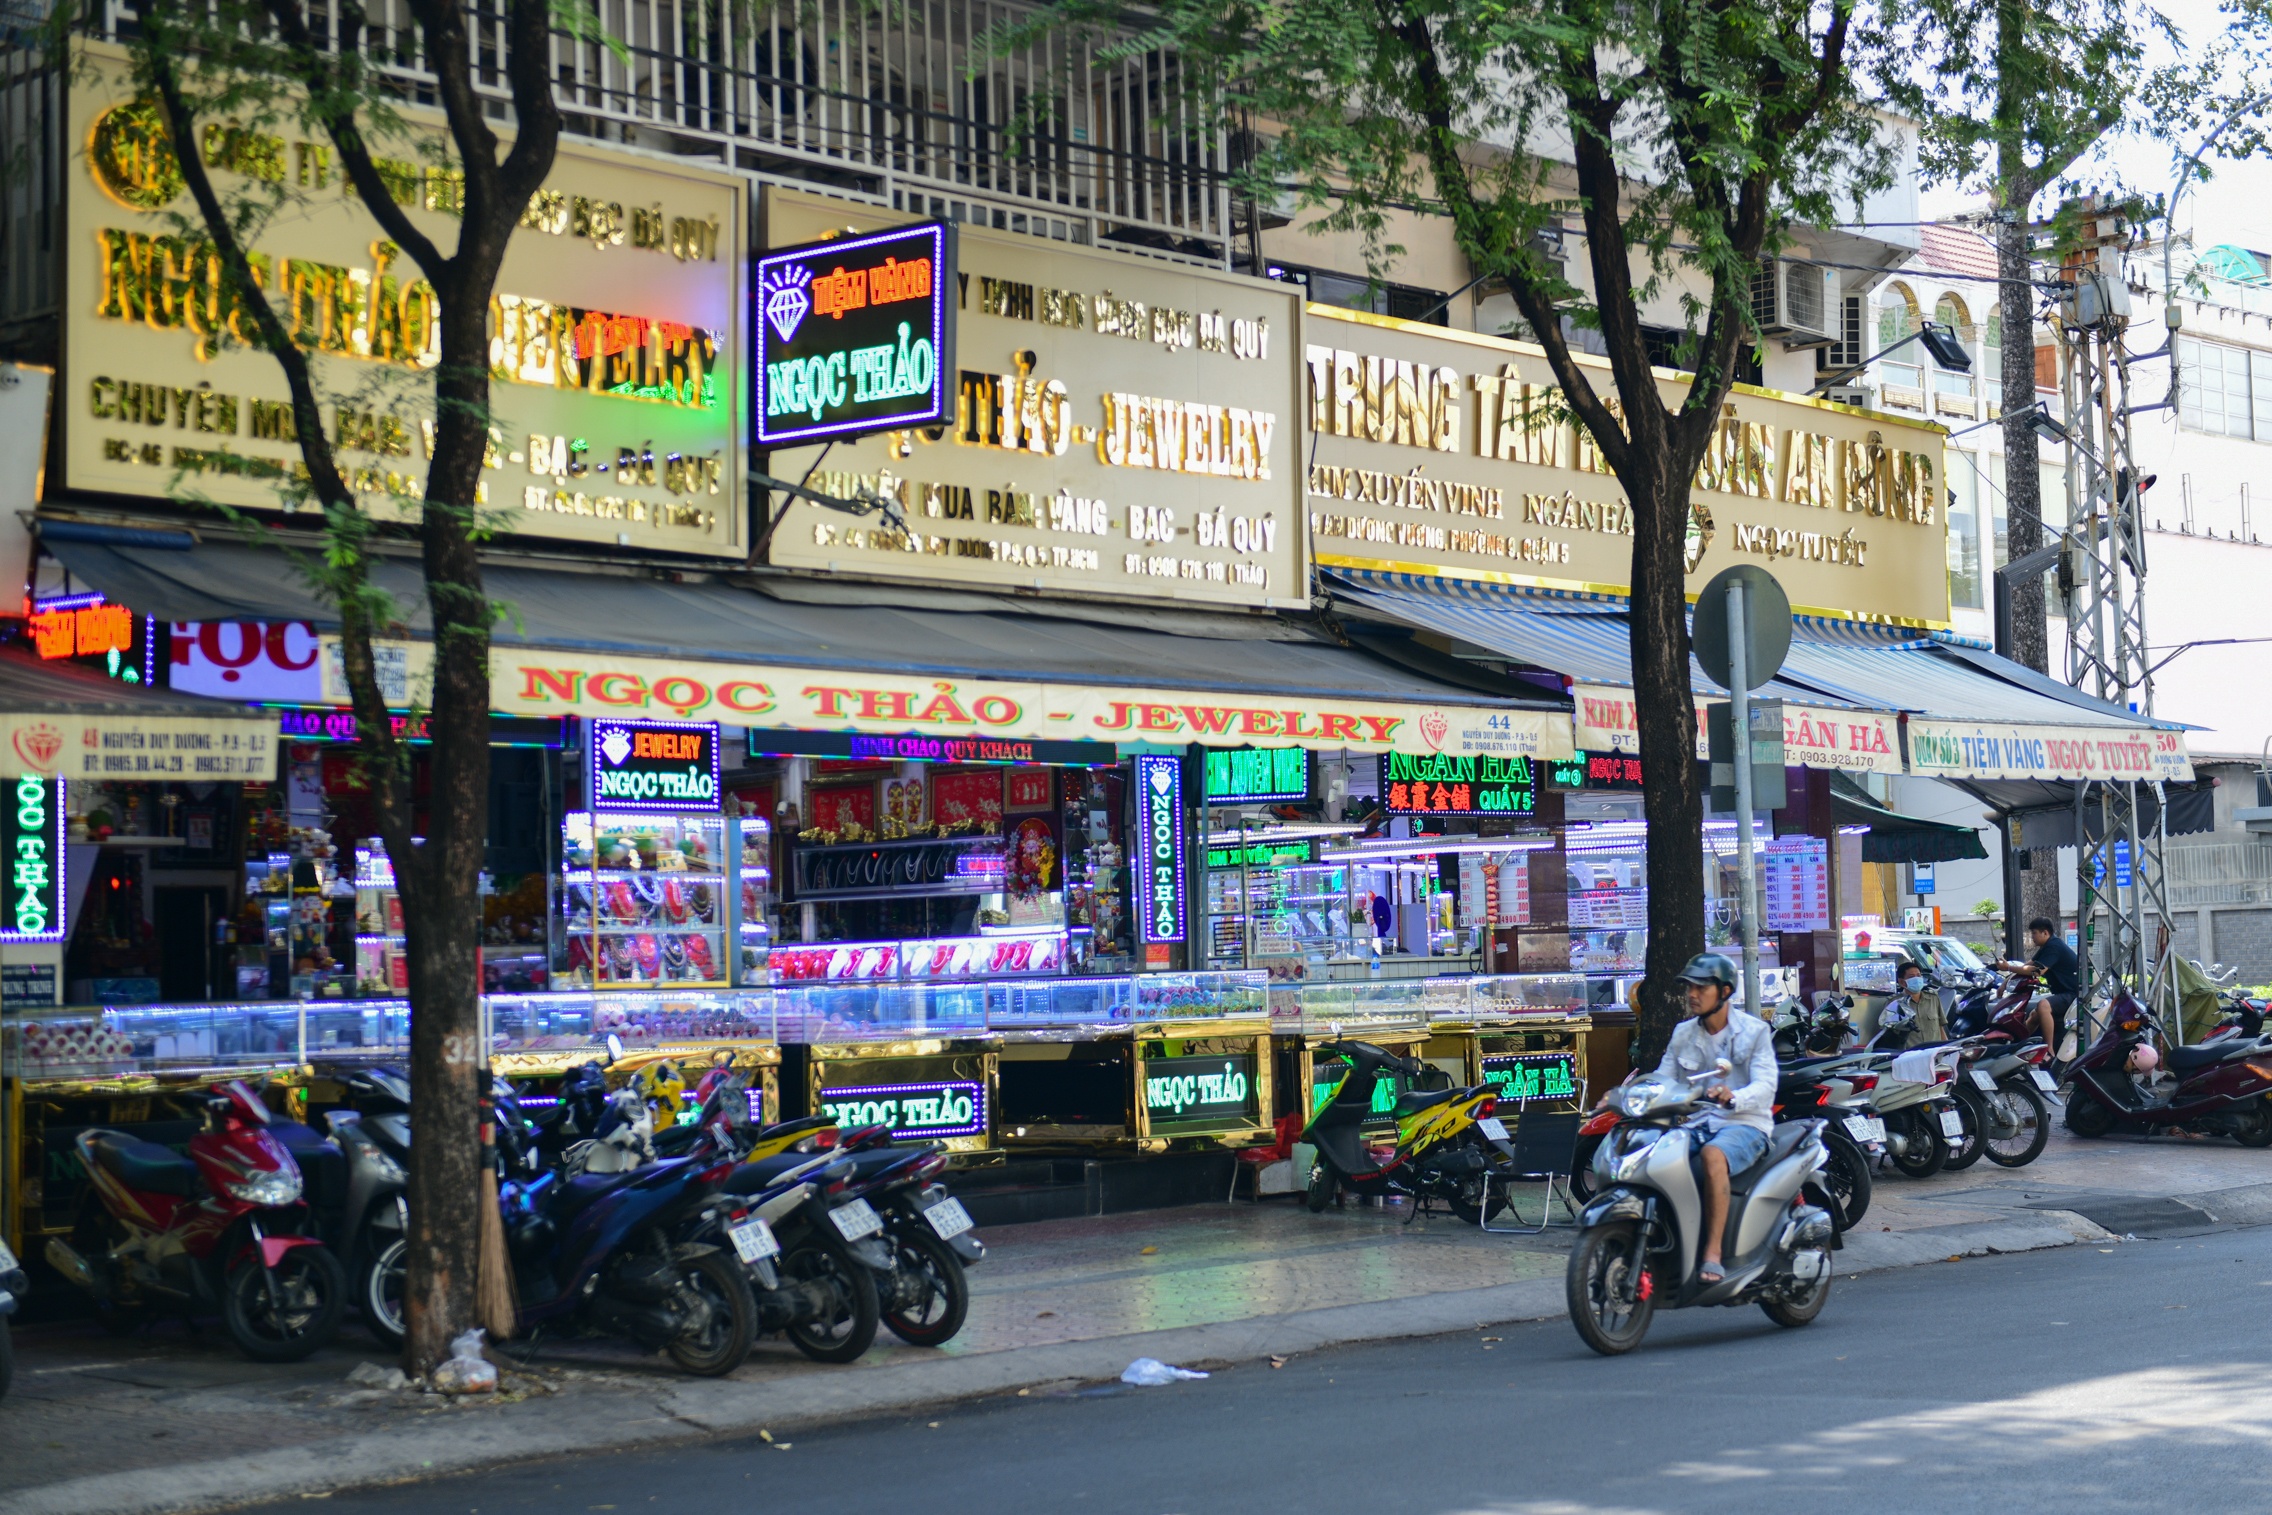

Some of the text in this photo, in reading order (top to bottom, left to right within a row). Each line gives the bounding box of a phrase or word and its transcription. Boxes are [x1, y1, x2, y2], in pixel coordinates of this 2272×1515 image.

[869, 257, 932, 306] VÀNG
[1199, 308, 1227, 355] ĐÁ
[1232, 315, 1270, 361] QUÝ
[766, 351, 848, 422] NGỌC
[850, 320, 935, 403] THẢO
[91, 376, 239, 436] CHUYÊN
[528, 433, 590, 486] BẠC
[616, 440, 657, 487] ĐÁ
[664, 449, 723, 496] QUÝ
[955, 349, 1072, 457] THẢO
[1097, 391, 1276, 481] JEWELRY
[1306, 343, 1461, 454] TRUNG
[1472, 362, 1567, 468] TÂM
[1784, 428, 1835, 508] AN
[1841, 429, 1935, 526] ĐÔNG
[920, 482, 975, 522] MUA
[1049, 486, 1109, 537] VÀNG
[1126, 504, 1176, 548] BẠC
[1197, 504, 1230, 548] ĐÁ
[1233, 510, 1277, 555] QUÝ
[1347, 515, 1394, 544] DƯƠNG
[1450, 529, 1506, 557] PHƯỜNG
[1523, 537, 1559, 565] QUẬN
[1561, 543, 1571, 563] 5
[1357, 464, 1441, 513] XUYẾN
[1442, 480, 1505, 521] VINH
[1526, 490, 1598, 533] NGÂN
[1734, 521, 1796, 562] NGỌC
[1799, 526, 1867, 567] TUYẾT
[517, 666, 775, 717] NGỌC
[803, 682, 1024, 726] THẢO
[1093, 702, 1405, 744] JEWELRY
[1487, 714, 1511, 730] 44
[1582, 697, 1624, 730] KIM
[1782, 710, 1840, 749] GÂN
[1848, 718, 1893, 754] HÀ
[632, 732, 702, 760] JEWELRY
[897, 734, 941, 758] CHÀO
[944, 734, 976, 762] QUÝ
[980, 739, 1033, 760] KHÁCH
[1482, 731, 1494, 740] DUY
[1611, 734, 1636, 747] ĐT:
[1800, 750, 1874, 768] 0903.928.170
[1940, 730, 1953, 764] SỐ
[1953, 736, 1960, 765] 3
[1961, 729, 2002, 776] TIỆM
[2003, 730, 2044, 770] VÀNG
[2045, 740, 2096, 778] NGỌC
[2097, 734, 2154, 772] TUYẾT
[2156, 733, 2177, 753] 50
[599, 765, 714, 801] NGỌC THẢO
[1589, 758, 1621, 783] NGỌC
[1478, 783, 1531, 811] QUẦY 5
[14, 834, 49, 934] THẢO
[1152, 794, 1175, 938] NGỌC THẢO
[444, 1035, 479, 1064] 32
[1147, 1062, 1247, 1114] NGỌC THẢO
[1485, 1062, 1540, 1099] NGÂN
[902, 1088, 974, 1126] THẢO
